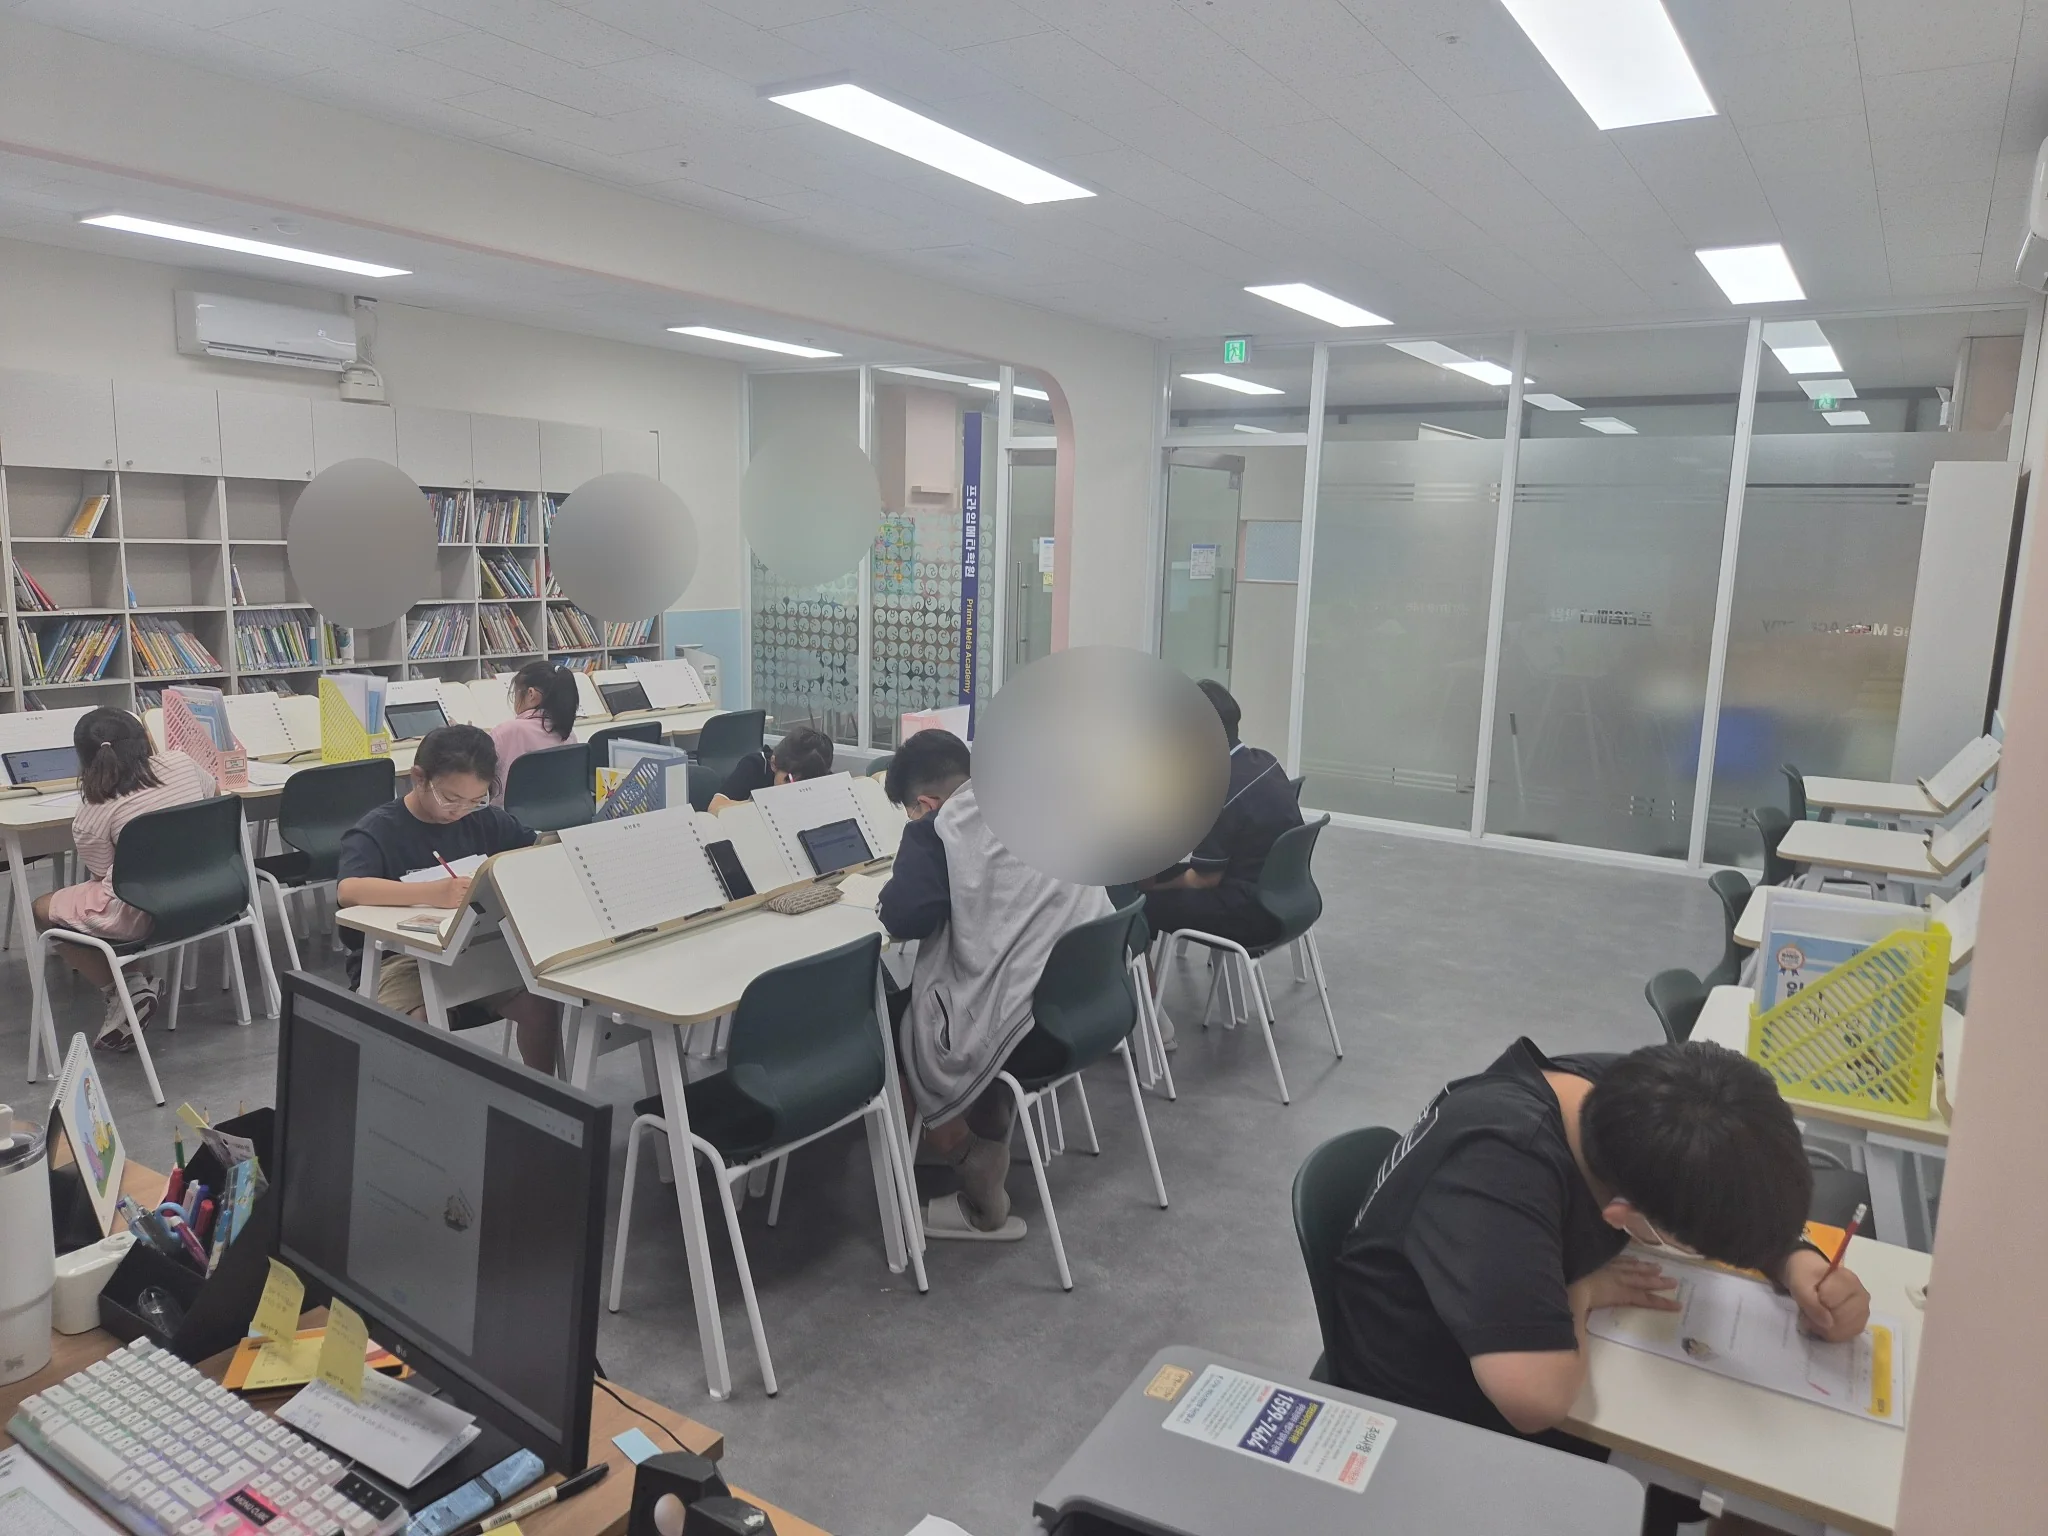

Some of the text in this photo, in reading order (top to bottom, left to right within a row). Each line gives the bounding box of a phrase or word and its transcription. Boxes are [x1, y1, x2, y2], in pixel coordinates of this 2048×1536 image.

[965, 485, 977, 578] 프라임메타학원
[965, 627, 973, 650] Meta
[963, 651, 972, 694] Academy
[1246, 1393, 1294, 1450] 1599-7464
